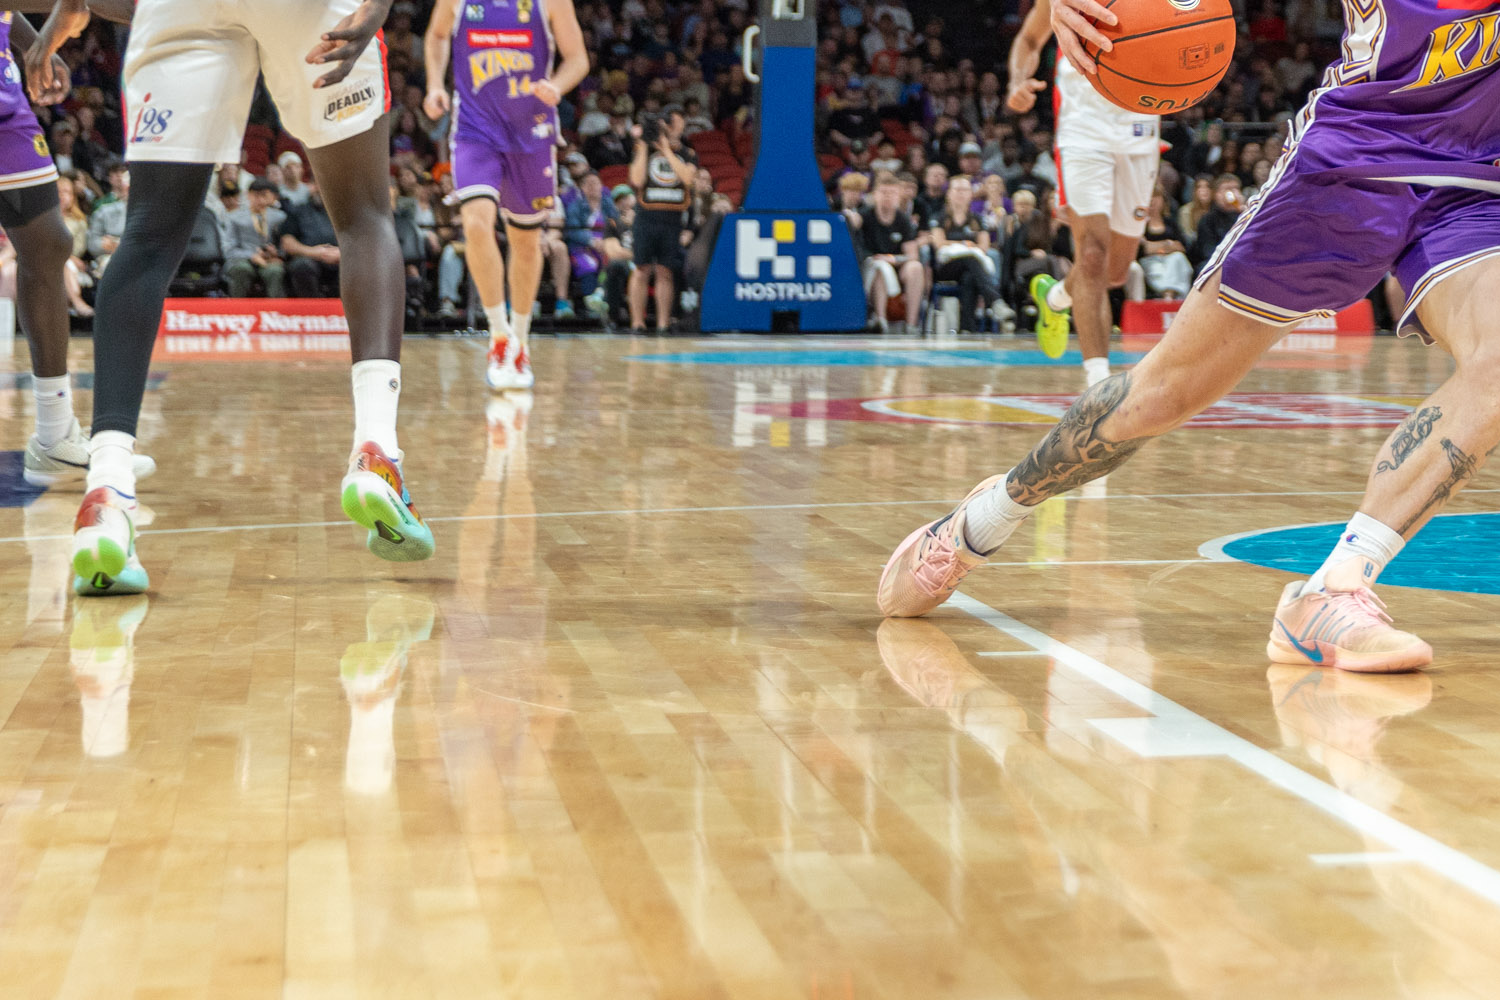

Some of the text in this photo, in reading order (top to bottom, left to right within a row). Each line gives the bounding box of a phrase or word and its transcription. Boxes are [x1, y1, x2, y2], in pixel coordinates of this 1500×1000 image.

[468, 48, 535, 94] KINGS
[327, 86, 373, 115] DEADLY
[507, 74, 532, 99] 14
[735, 281, 832, 301] HOSTPLUS
[165, 311, 349, 340] Harvey Norma
